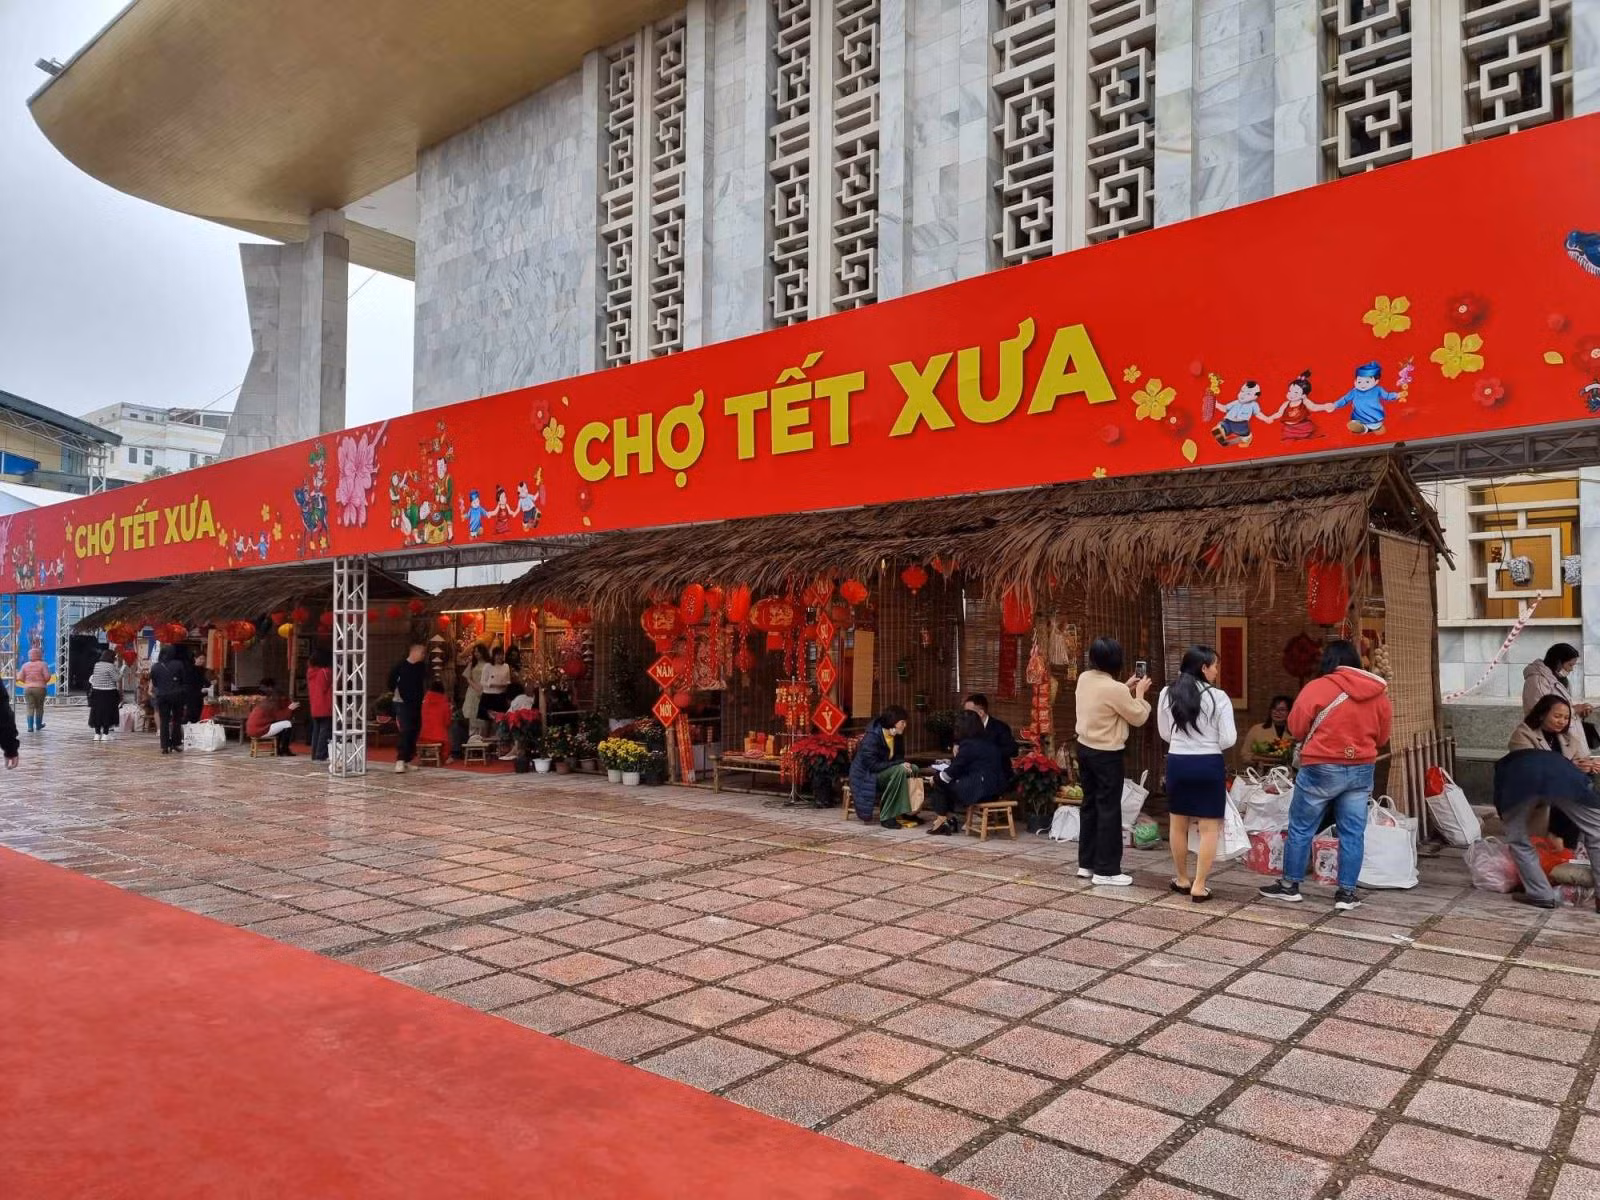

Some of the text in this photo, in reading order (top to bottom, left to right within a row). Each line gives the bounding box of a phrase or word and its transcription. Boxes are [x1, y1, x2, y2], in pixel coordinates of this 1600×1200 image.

[573, 316, 1118, 488] CHỢ TẾT XƯA
[74, 493, 217, 565] CHỢ TẾT XƯA
[821, 705, 834, 731] Ý
